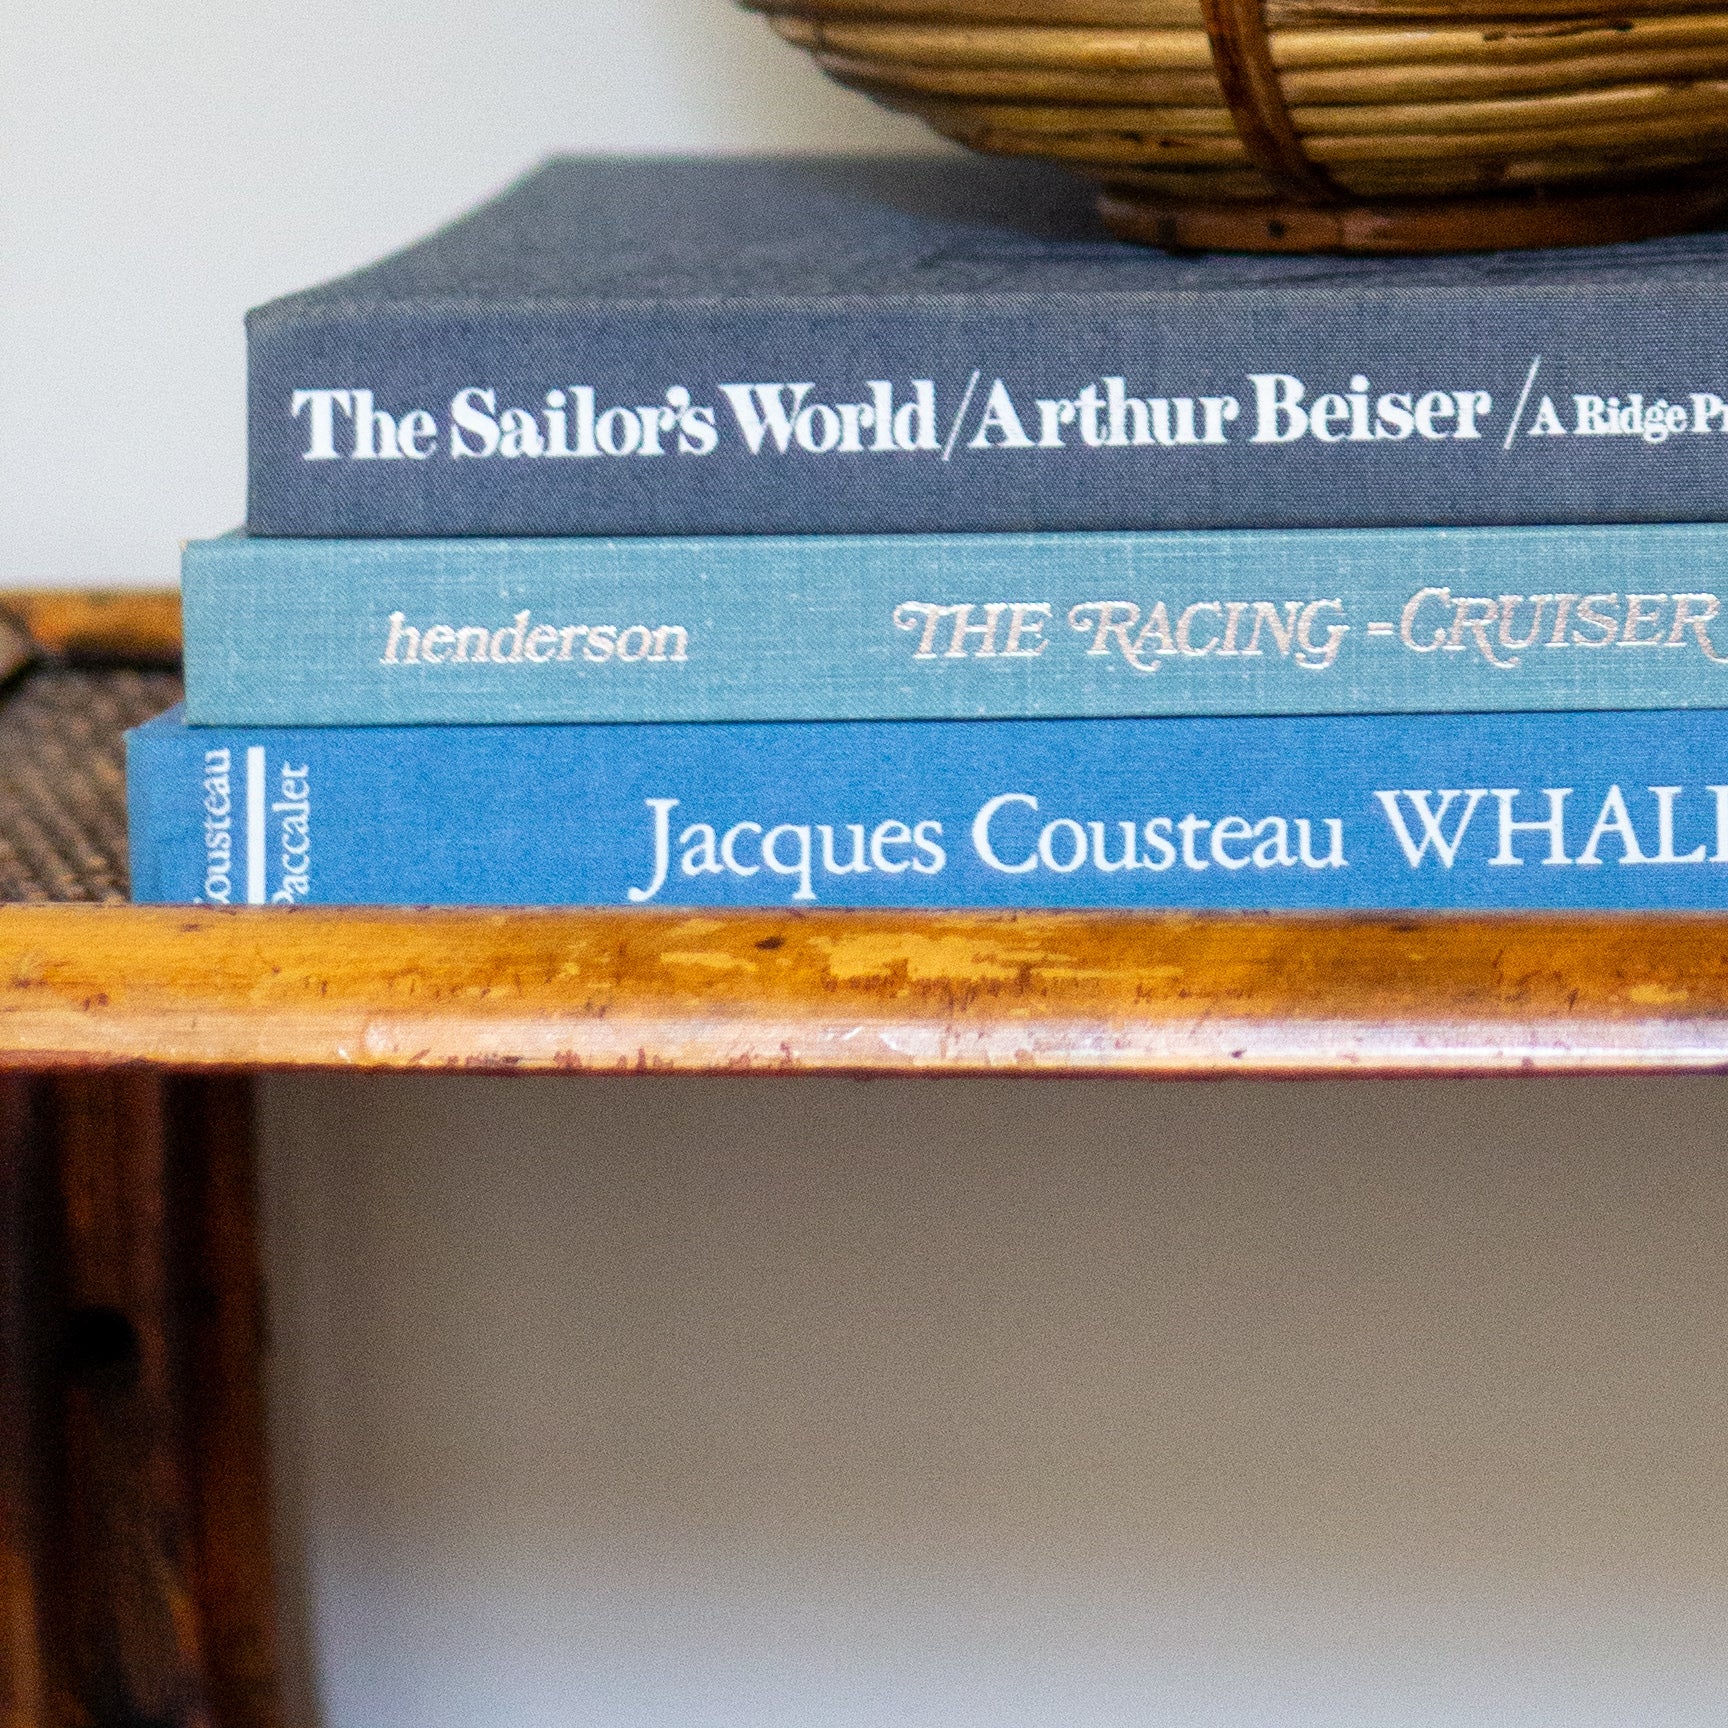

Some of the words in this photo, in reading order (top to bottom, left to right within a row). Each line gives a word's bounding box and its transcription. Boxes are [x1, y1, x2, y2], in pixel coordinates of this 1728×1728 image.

[290, 389, 437, 461] The
[450, 385, 718, 461] Sailor's
[1247, 374, 1492, 444] Beiser
[1573, 393, 1688, 444] Ridge
[379, 609, 689, 667] henderson
[892, 600, 1053, 661] THE
[193, 747, 232, 904] ousteau
[627, 798, 946, 903] Jacques
[971, 793, 1349, 875] Cousteau
